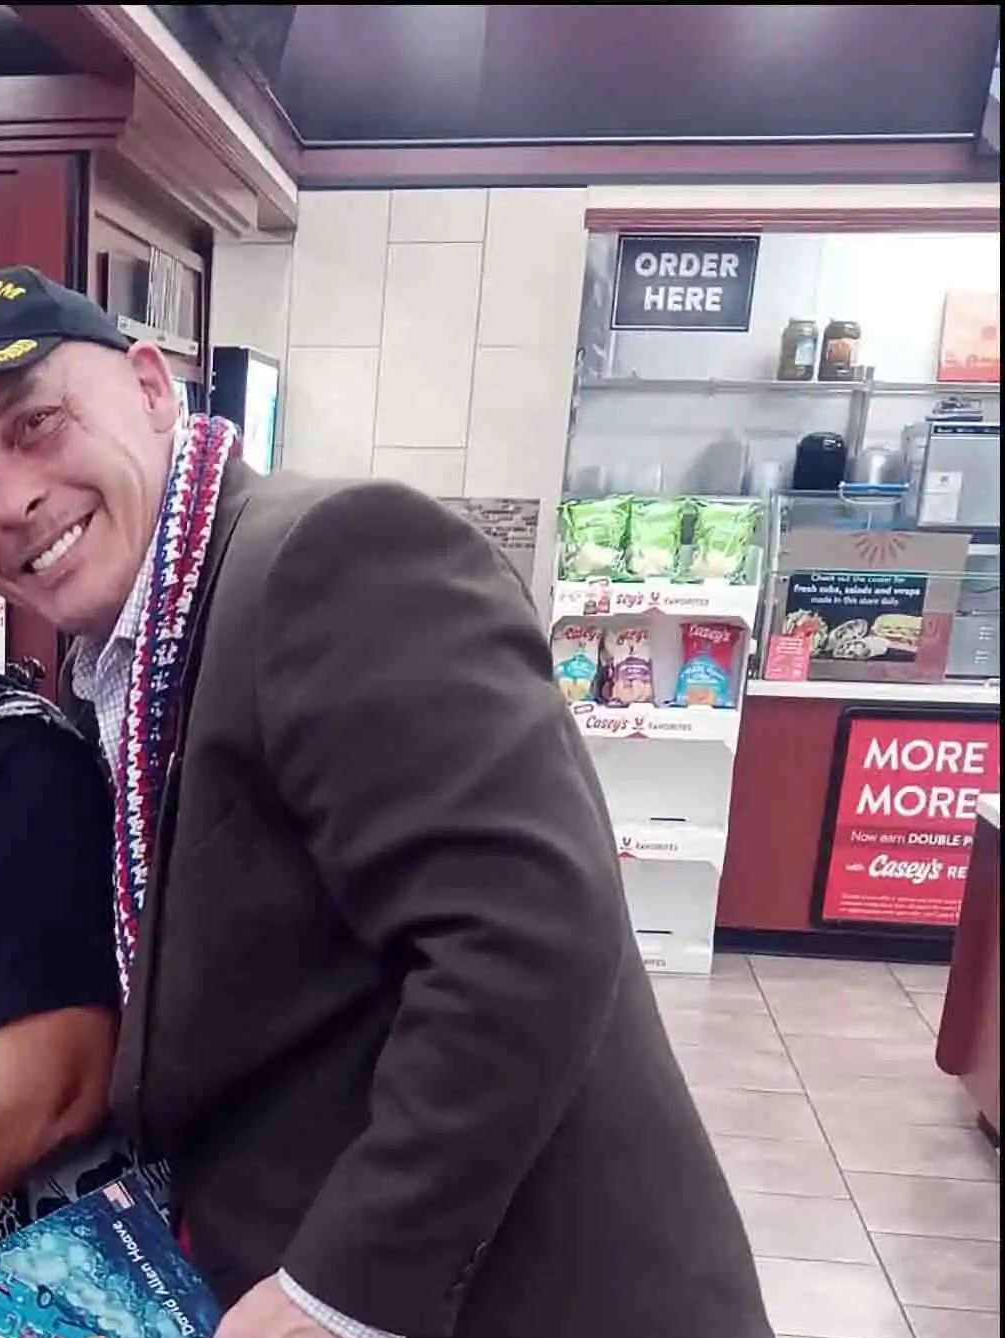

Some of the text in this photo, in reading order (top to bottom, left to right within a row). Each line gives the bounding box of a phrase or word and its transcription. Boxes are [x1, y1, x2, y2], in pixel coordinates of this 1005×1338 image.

[635, 252, 739, 279] ORDER
[644, 286, 723, 312] HERE
[794, 584, 920, 596] fresh subs, salads and wraps
[834, 596, 841, 604] in
[843, 596, 858, 605] this
[690, 625, 732, 644] Casey's
[585, 716, 629, 732] Casey's
[863, 737, 989, 775] MORE
[856, 784, 980, 819] MORE
[850, 831, 877, 842] Now
[880, 834, 906, 845] earn
[908, 834, 960, 846] DOUBLE
[868, 853, 943, 884] Casey's
[138, 1261, 169, 1299] Allen
[162, 1297, 196, 1337] David
